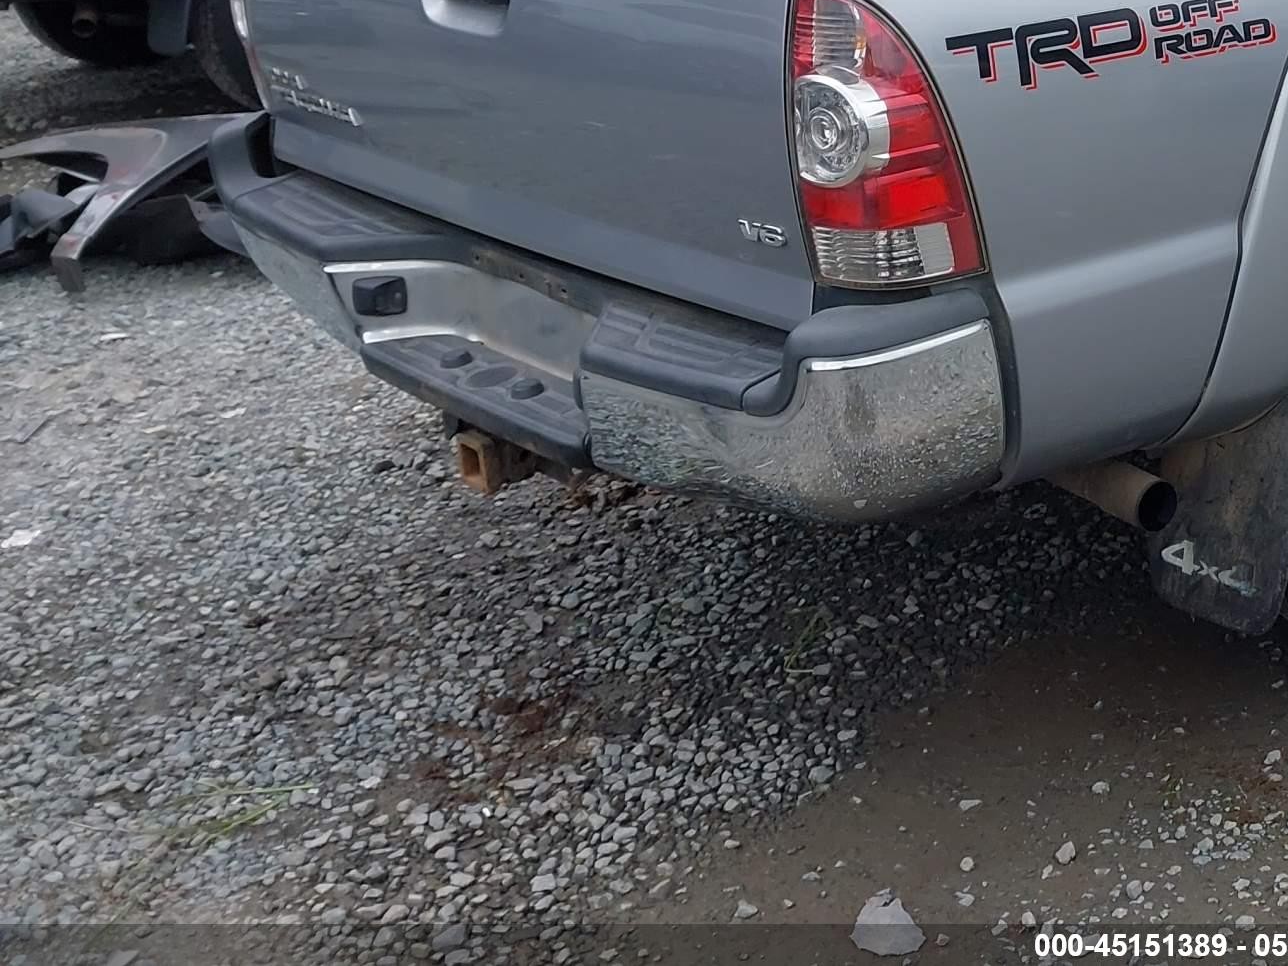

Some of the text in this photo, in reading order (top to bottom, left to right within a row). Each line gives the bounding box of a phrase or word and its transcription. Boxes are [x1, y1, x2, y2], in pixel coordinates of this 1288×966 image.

[944, 8, 1147, 90] TRD
[1153, 17, 1278, 64] ROAD
[737, 219, 786, 247] V6
